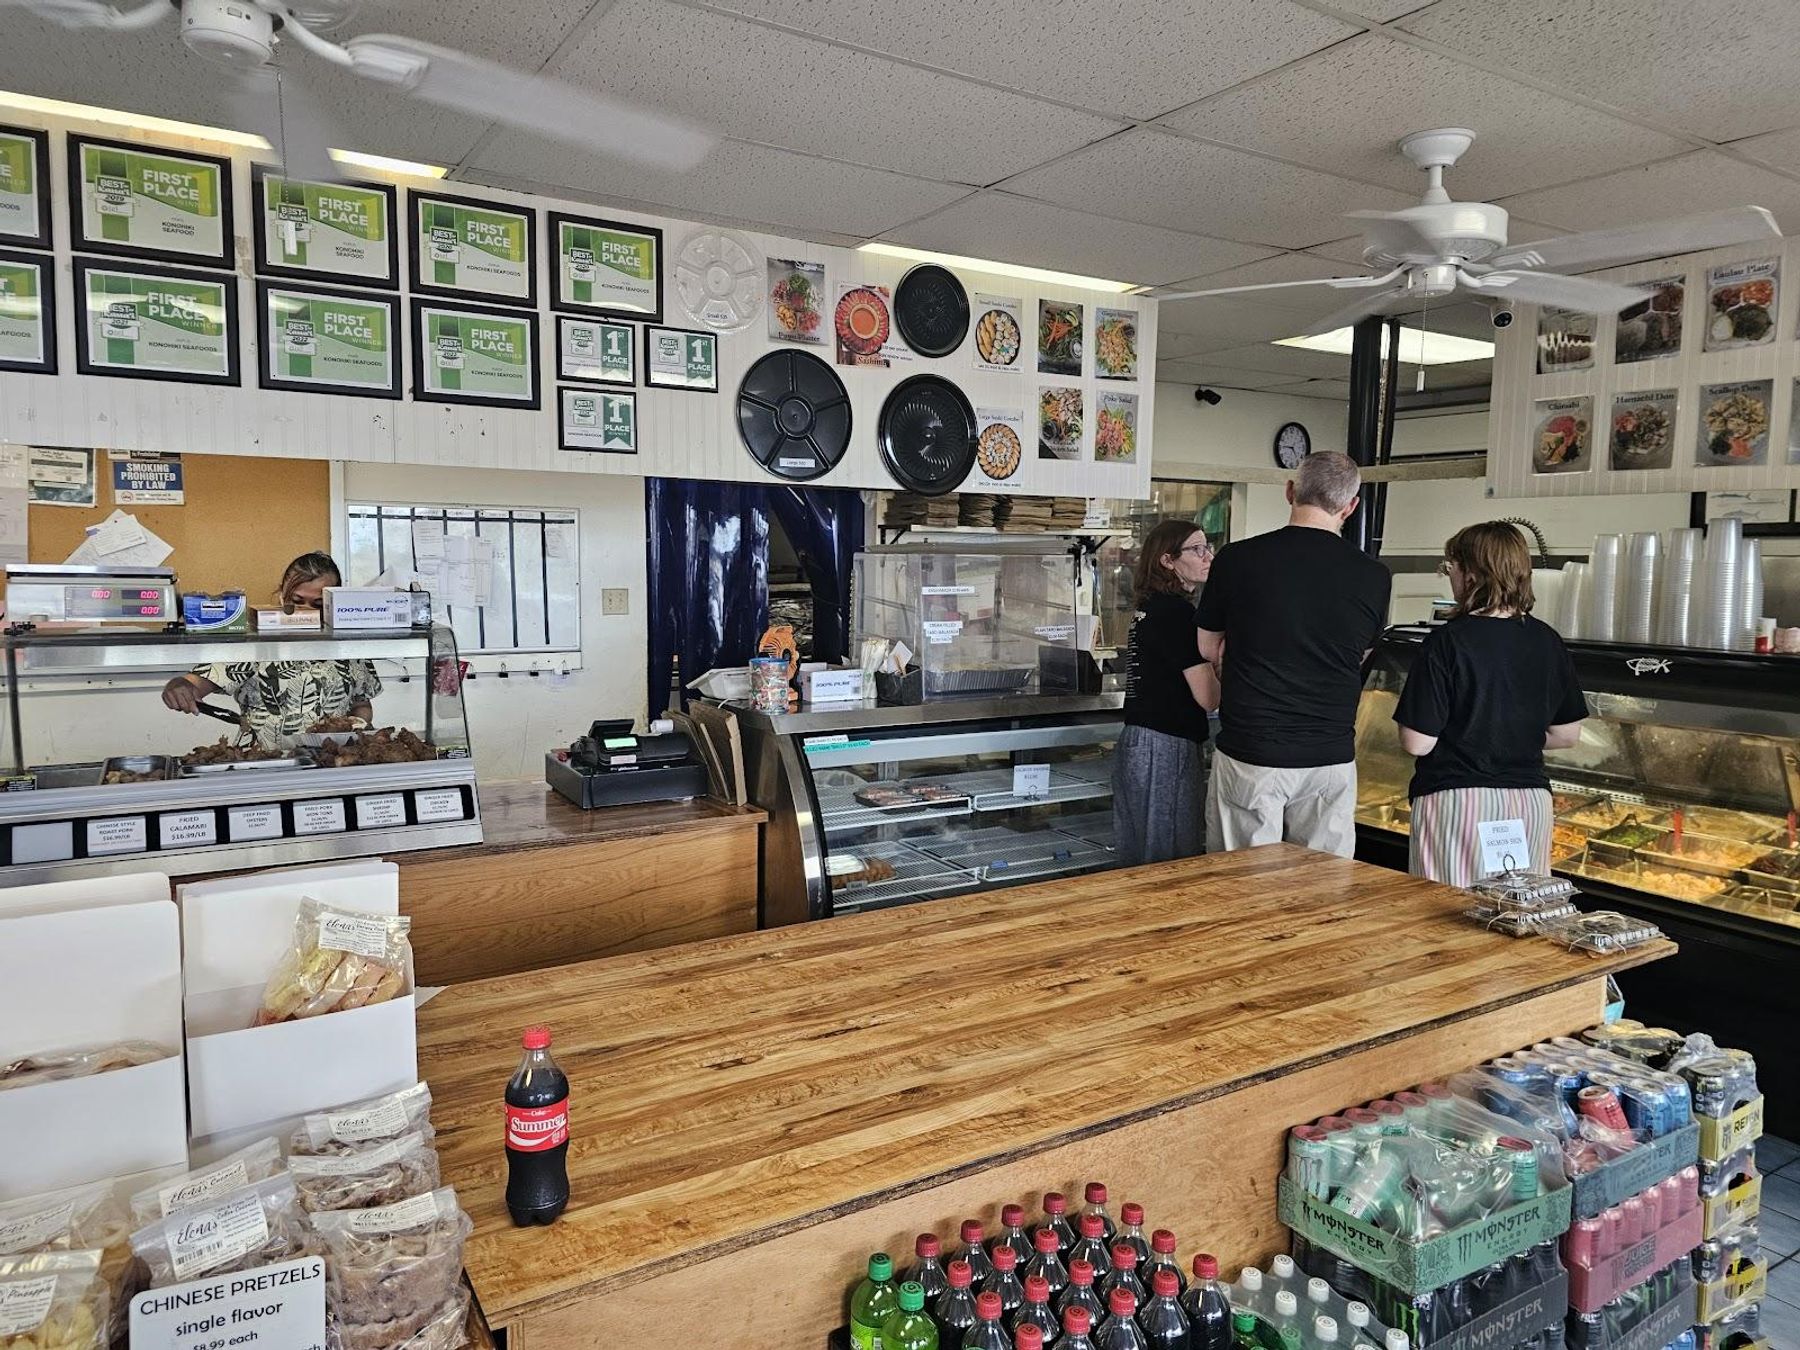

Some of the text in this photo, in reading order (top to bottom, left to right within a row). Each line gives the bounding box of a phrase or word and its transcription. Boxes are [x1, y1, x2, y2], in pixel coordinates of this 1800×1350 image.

[142, 169, 193, 187] FIRST
[143, 182, 199, 200] PLACE
[319, 196, 362, 212] FIRST
[319, 209, 368, 226] PLACE
[467, 220, 505, 236] FIRST
[468, 232, 511, 248] PLACE
[602, 241, 636, 255] FIRST
[602, 252, 641, 267] PLACE
[1746, 263, 1771, 274] Plate
[148, 292, 197, 307] FIRST
[148, 305, 205, 320] PLACE
[324, 312, 365, 326] FIRST
[0, 329, 31, 338] AFOODS
[325, 324, 372, 339] PLACE
[471, 329, 508, 341] FIRST
[471, 340, 515, 353] PLACE
[603, 356, 628, 364] PLACE
[688, 363, 711, 371] PLACE
[1709, 387, 1738, 396] Scallop
[605, 424, 630, 432] PLACE
[126, 463, 170, 472] SMOKING
[121, 472, 176, 481] PROHIBITED
[132, 481, 167, 489] BY LAW
[170, 823, 207, 832] CALAMARI
[1733, 1107, 1760, 1133] REIN
[1314, 1209, 1386, 1255] MONSTER
[1475, 1206, 1541, 1243] MONSTER
[140, 1263, 321, 1316] CHINESE PRETZELS
[175, 1302, 284, 1337] single flavor
[1471, 1298, 1543, 1349] MONSTER
[229, 1331, 259, 1346] each
